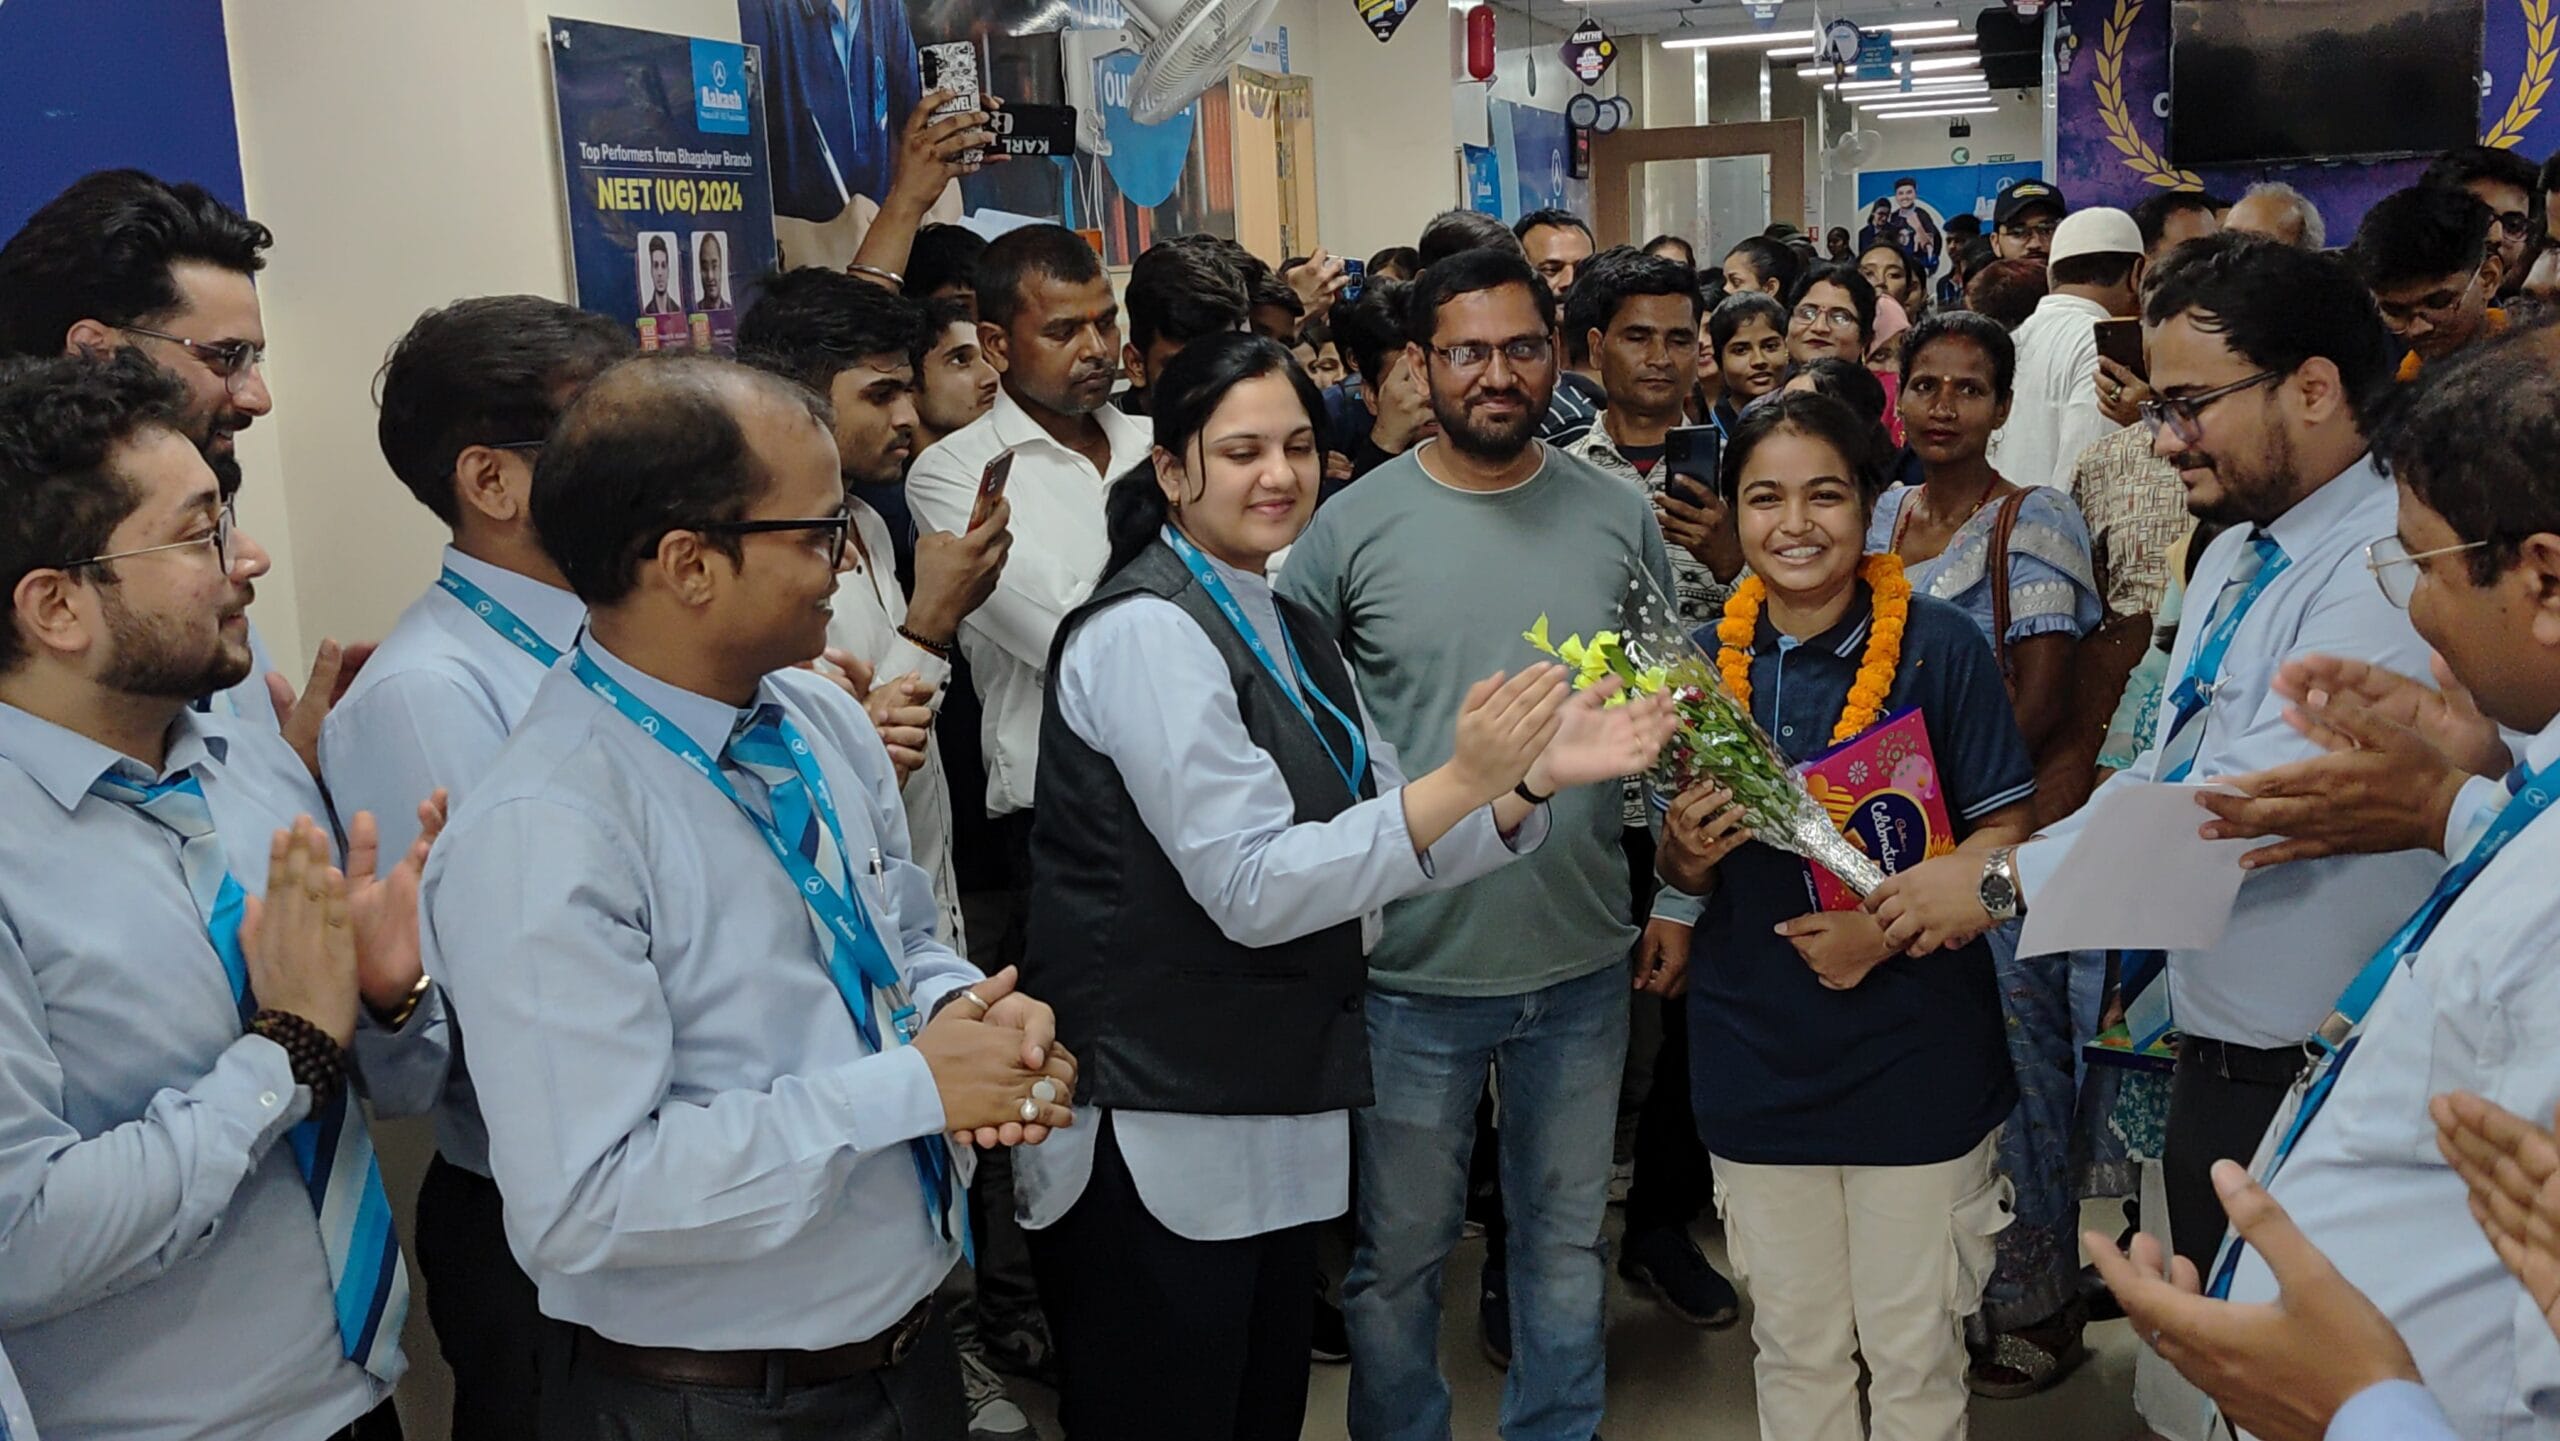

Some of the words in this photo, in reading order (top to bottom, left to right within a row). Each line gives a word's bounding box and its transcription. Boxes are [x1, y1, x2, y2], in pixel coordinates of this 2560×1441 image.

[1572, 31, 1603, 44] ANTHE
[578, 142, 601, 163] Top
[602, 143, 654, 163] Performers
[655, 147, 677, 163] from
[678, 148, 723, 169] Bhagalpur
[723, 151, 752, 168] Branch
[1002, 139, 1050, 155] KARL
[597, 177, 652, 211] NEET
[655, 178, 697, 217] (UG)
[698, 180, 743, 212] 2024
[1871, 801, 1900, 876] Celebration
